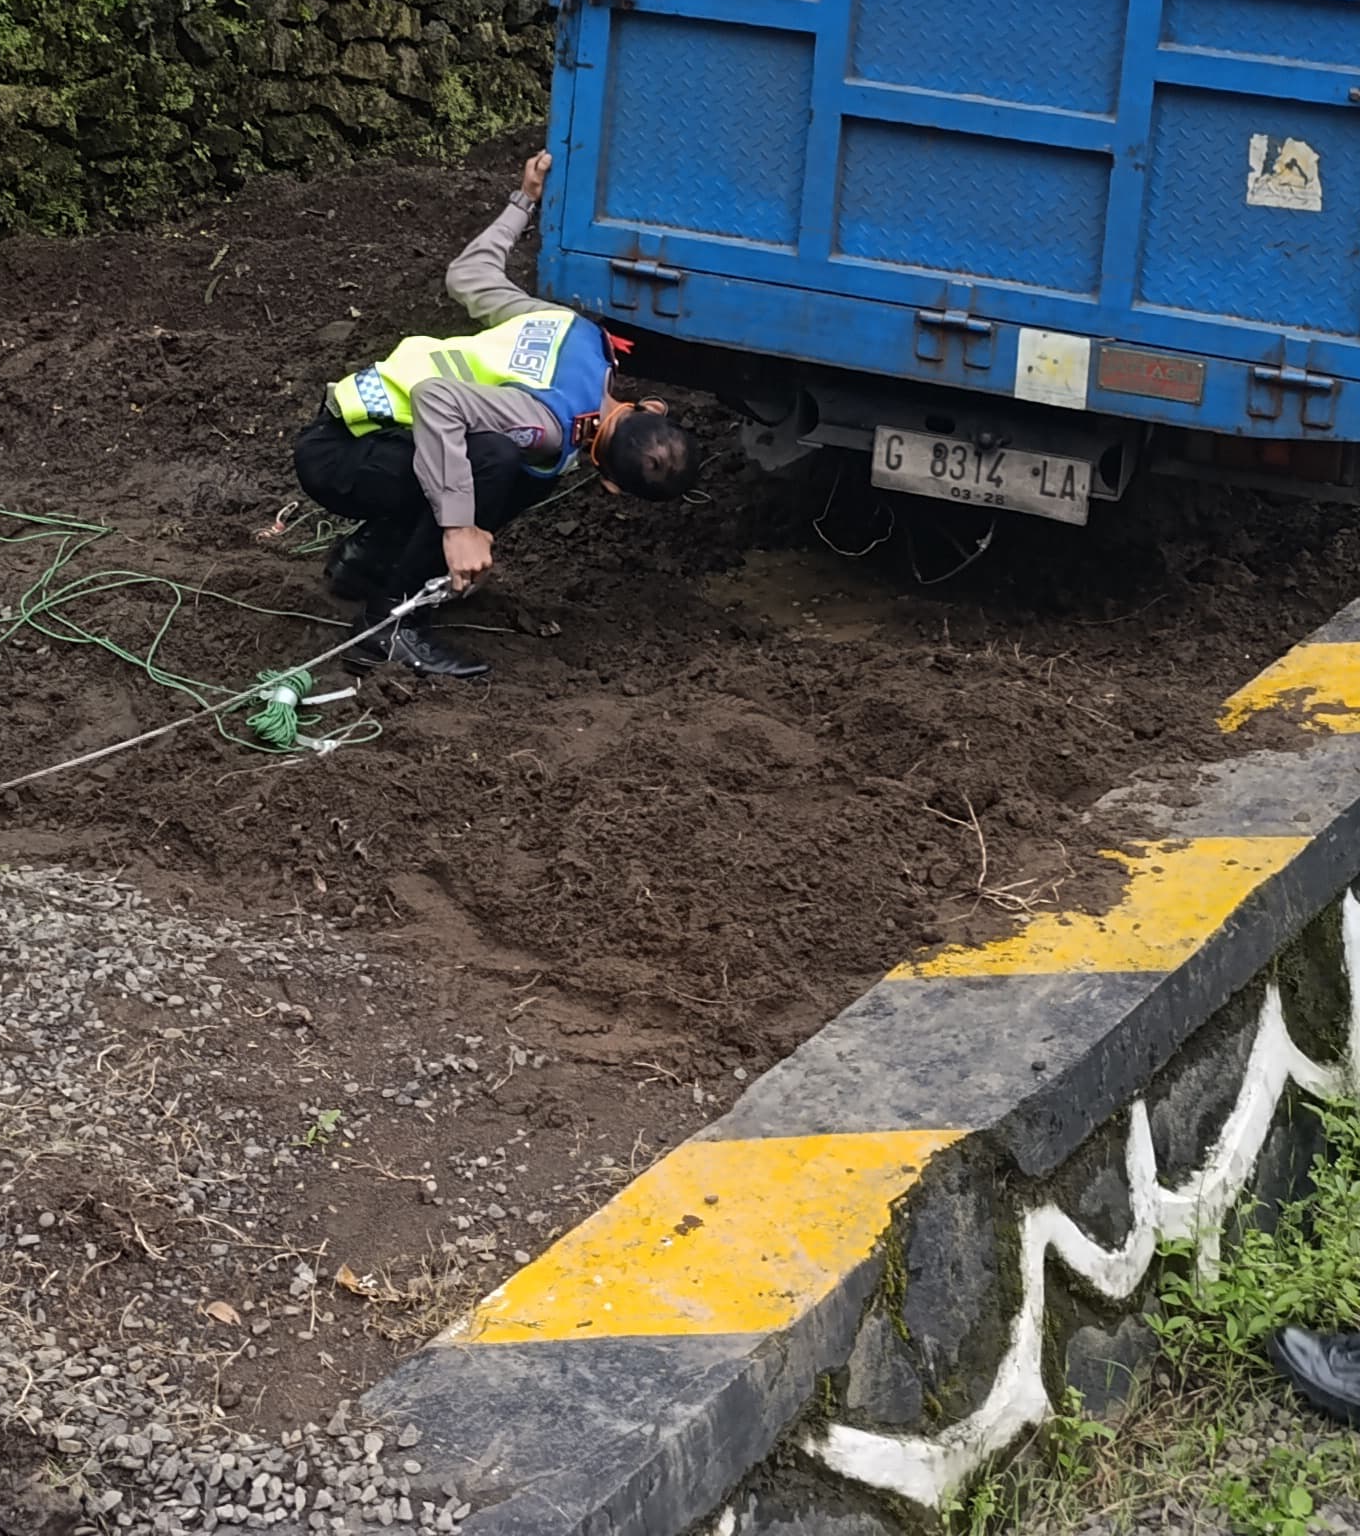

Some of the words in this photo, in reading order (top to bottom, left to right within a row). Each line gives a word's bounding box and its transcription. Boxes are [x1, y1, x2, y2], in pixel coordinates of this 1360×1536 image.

[886, 434, 904, 471] G
[930, 442, 1006, 489] 8314
[1039, 459, 1076, 502] LA
[950, 487, 1005, 505] 03-28
